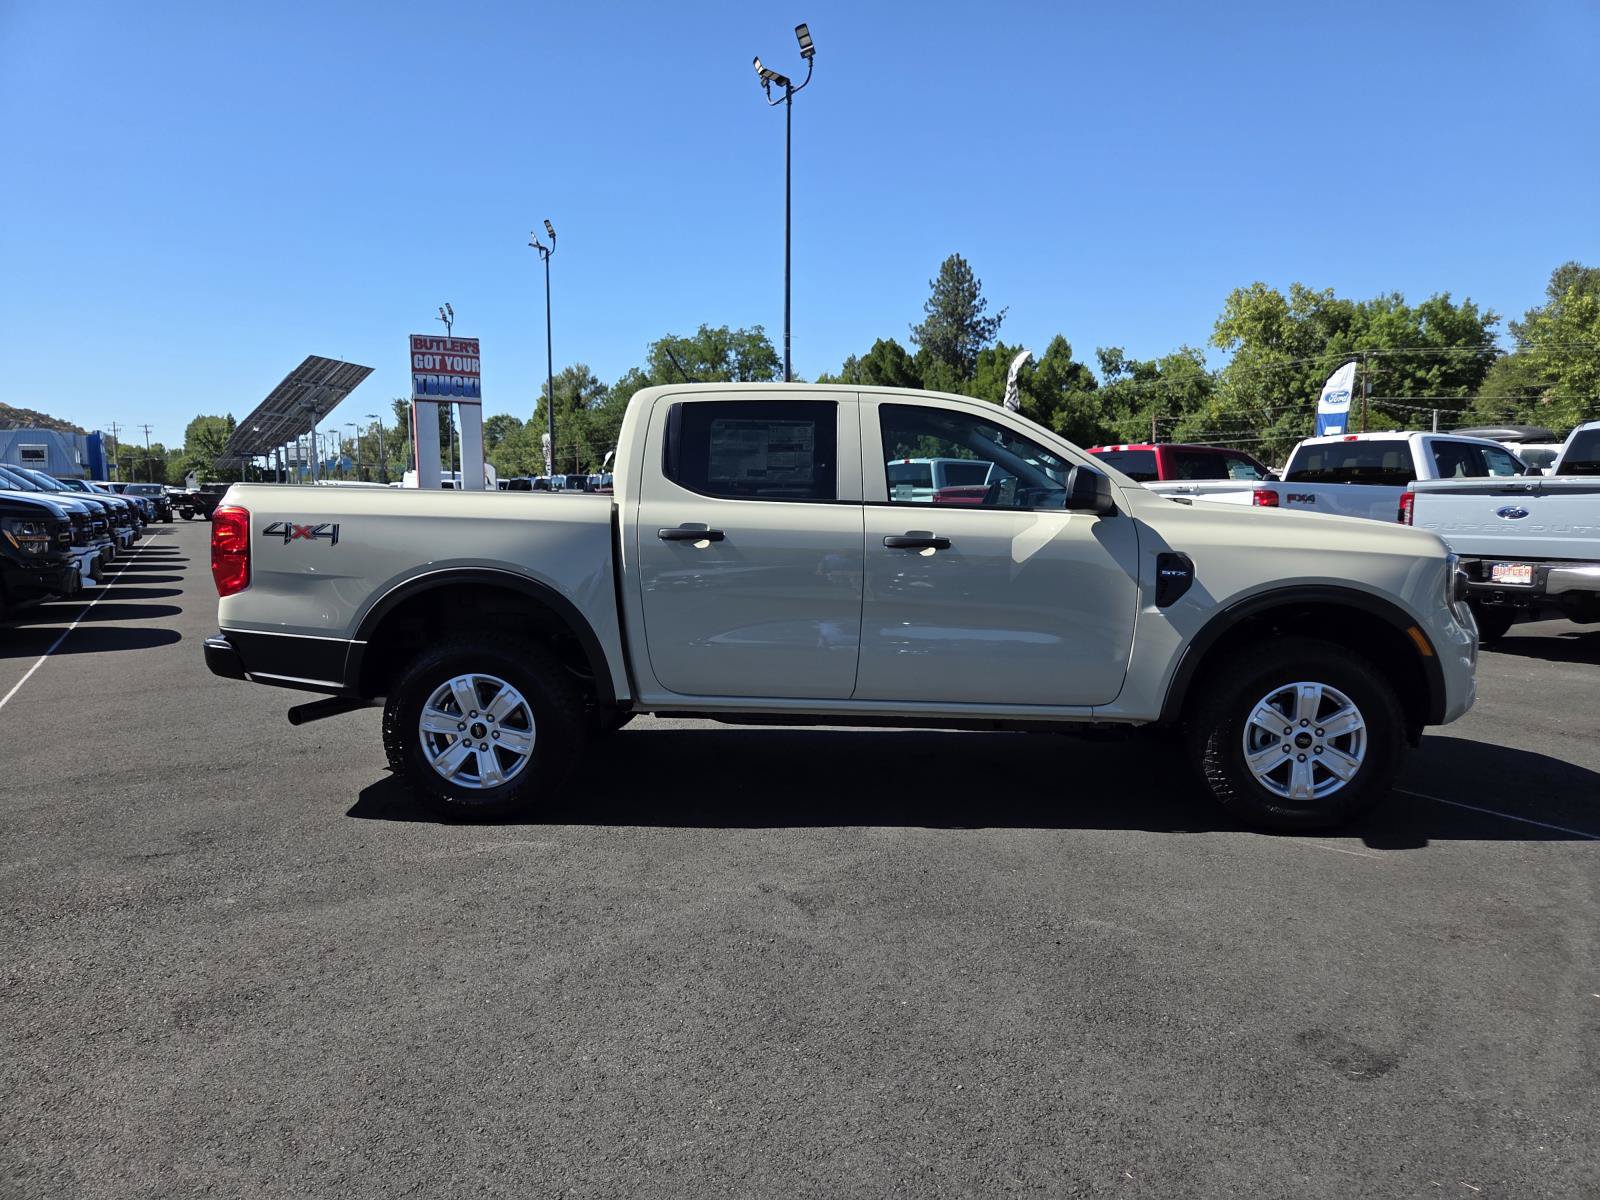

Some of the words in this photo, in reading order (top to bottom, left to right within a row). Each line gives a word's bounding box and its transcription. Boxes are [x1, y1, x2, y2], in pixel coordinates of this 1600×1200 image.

[413, 337, 479, 354] BUTLER'S
[414, 354, 441, 369] GOT
[445, 356, 480, 373] YOUR
